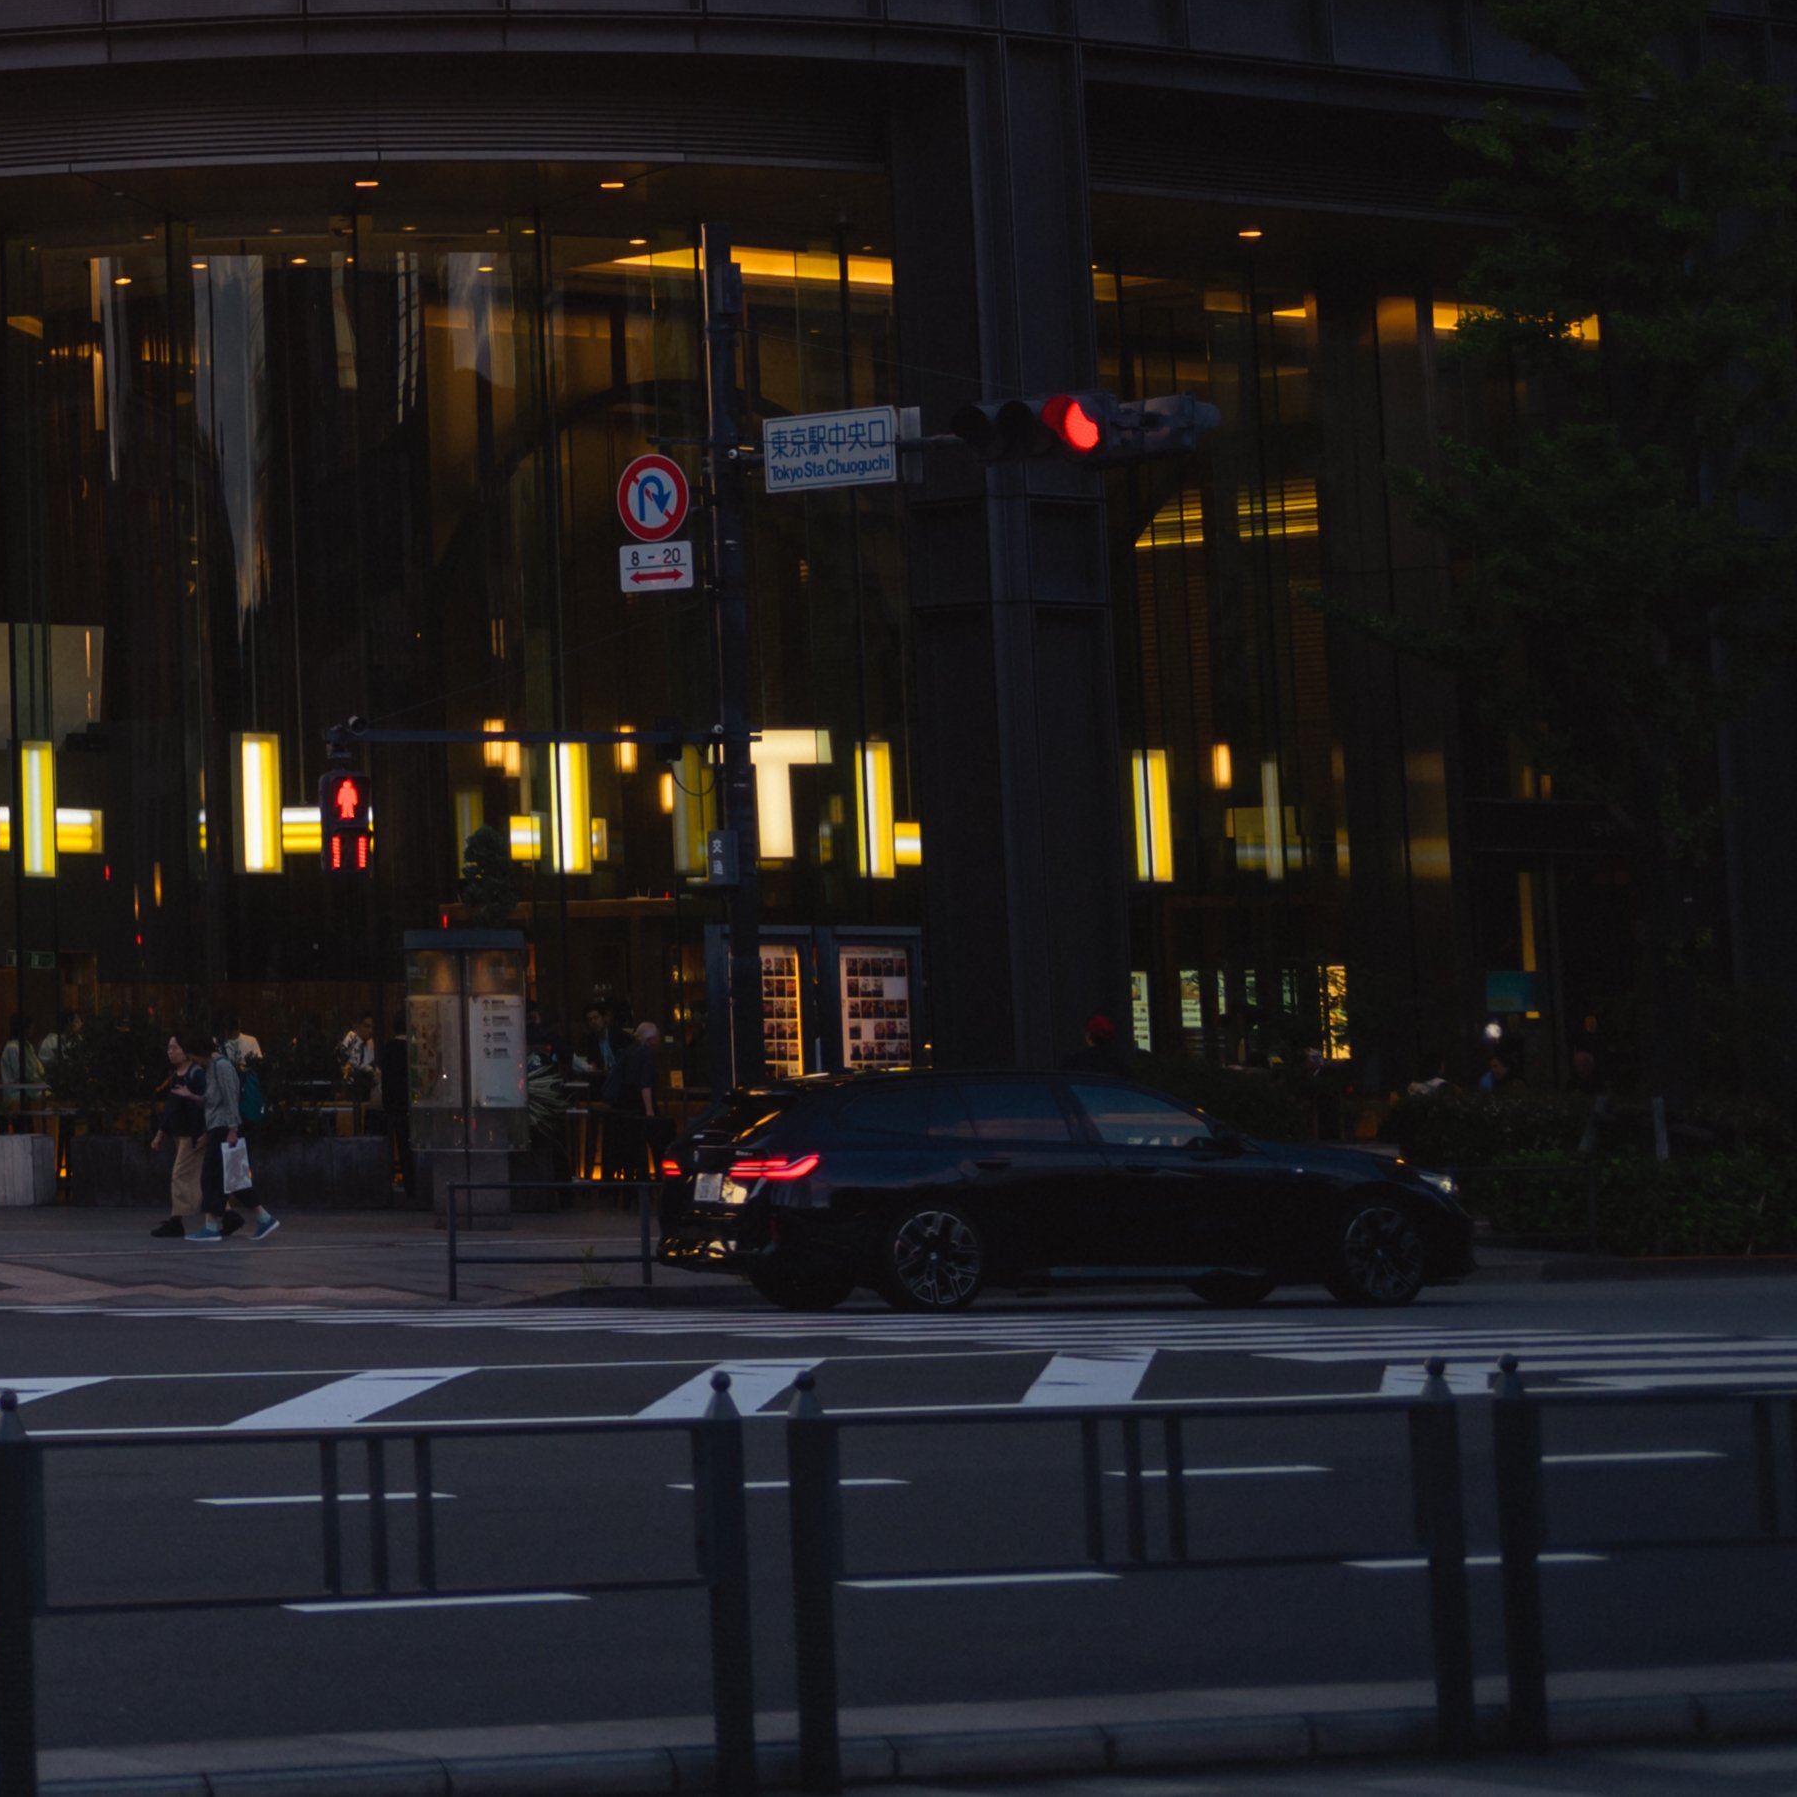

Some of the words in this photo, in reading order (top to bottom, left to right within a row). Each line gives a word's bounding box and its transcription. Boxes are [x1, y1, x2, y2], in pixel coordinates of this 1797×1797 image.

[770, 420, 886, 460] 東京駅中央口
[770, 464, 804, 482] Tokyo
[826, 453, 890, 476] Chuoguchi
